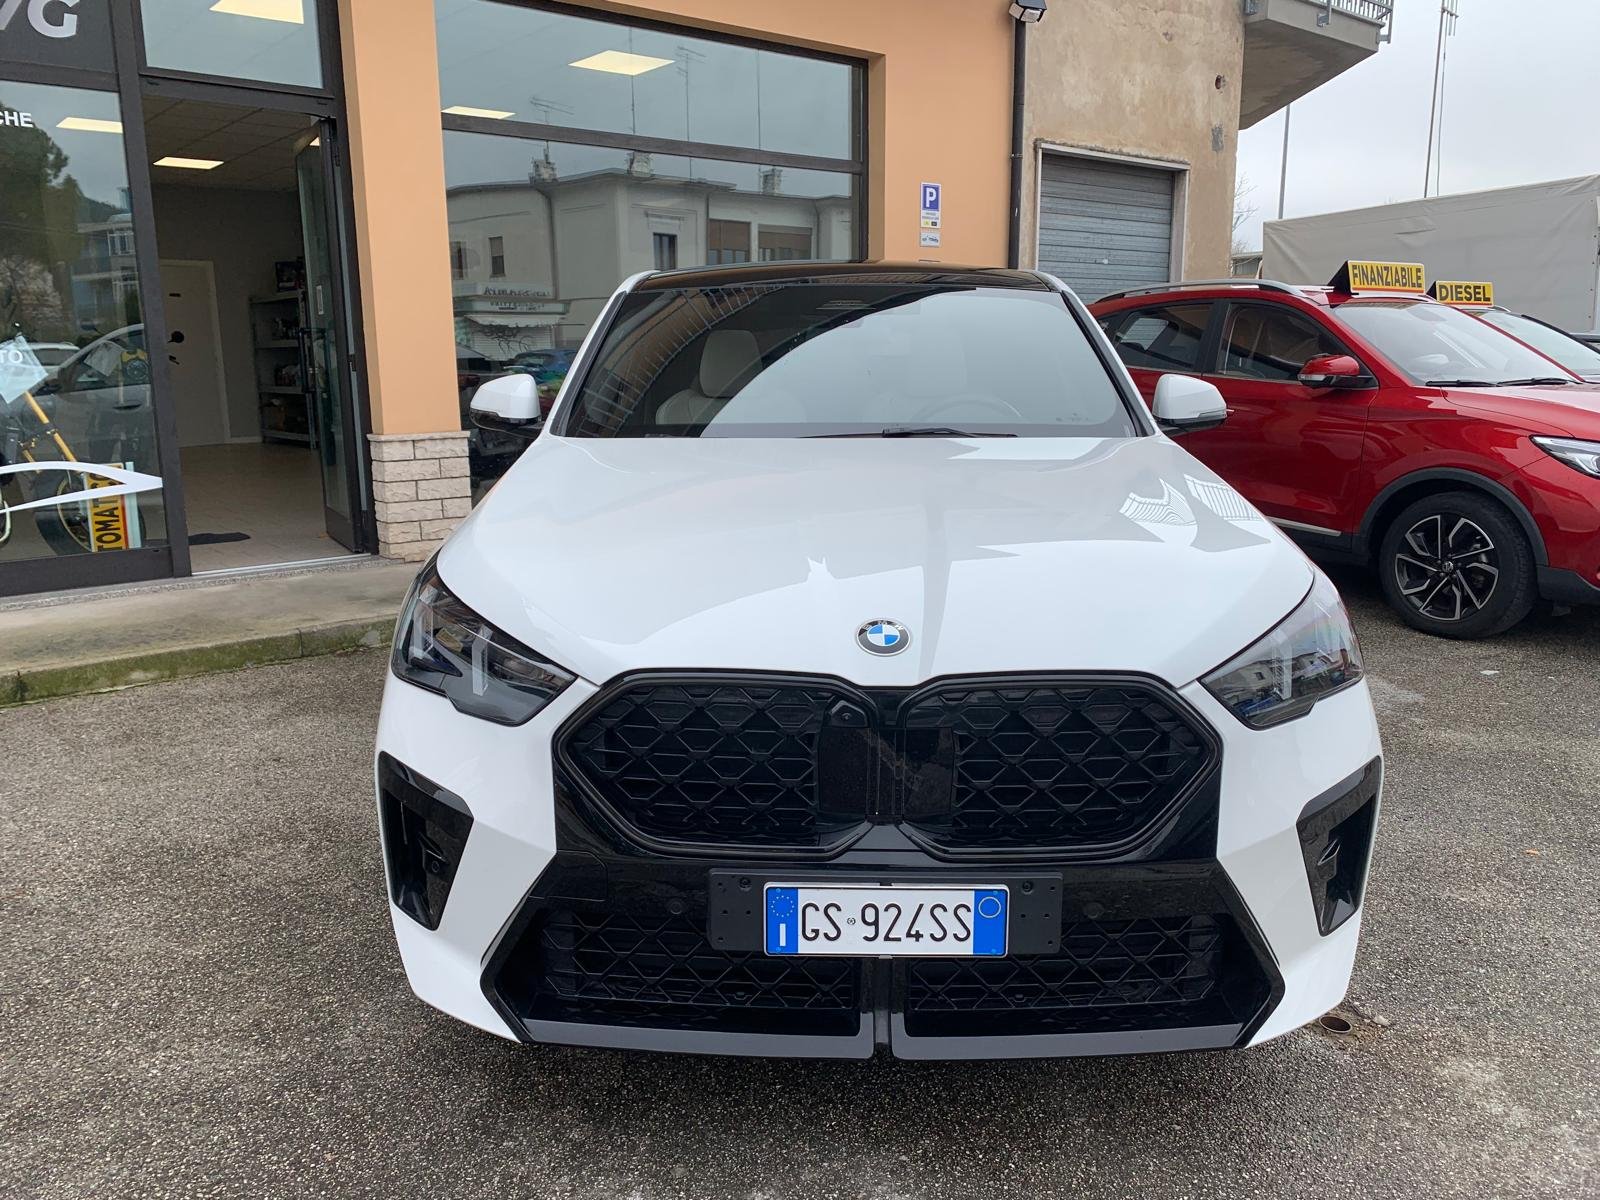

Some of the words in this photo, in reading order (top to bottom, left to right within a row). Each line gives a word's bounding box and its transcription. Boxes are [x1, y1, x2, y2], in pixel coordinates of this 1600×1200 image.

[925, 187, 937, 208] P
[1351, 264, 1423, 288] FINANZIABILE
[1438, 284, 1491, 302] DIESEL
[801, 902, 843, 942] GS
[860, 902, 972, 943] 924SS
